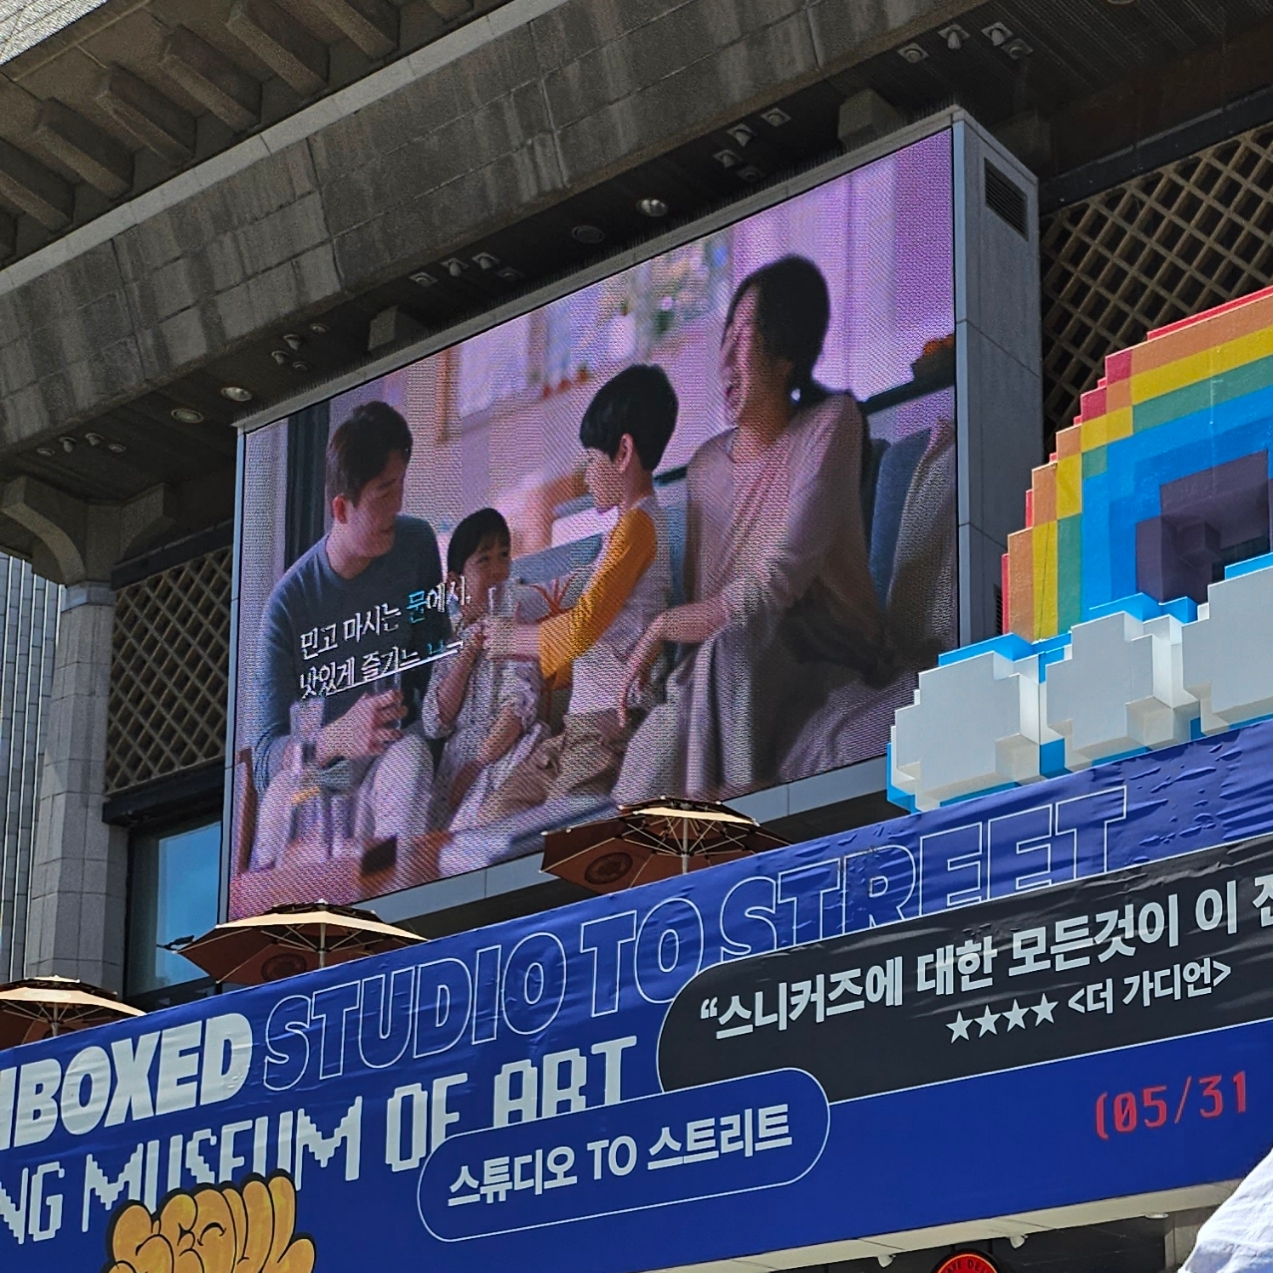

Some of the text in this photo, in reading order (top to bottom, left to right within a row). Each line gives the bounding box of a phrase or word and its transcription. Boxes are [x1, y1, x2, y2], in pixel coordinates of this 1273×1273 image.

[343, 603, 402, 642] 마시는
[262, 931, 567, 1092] STUDIO
[579, 897, 703, 1018] TO
[719, 785, 1127, 964] STREET
[916, 936, 998, 996] 대한
[1008, 893, 1180, 977] 모든것이
[1194, 880, 1239, 934] 이
[1122, 957, 1232, 1010] 가디언>
[82, 1096, 364, 1233] MUSEUM
[385, 1072, 468, 1173] OF
[493, 1035, 637, 1128] ART
[447, 1103, 793, 1207] 스튜디오 TO 스트리트
[1095, 1070, 1247, 1140] (05/31
